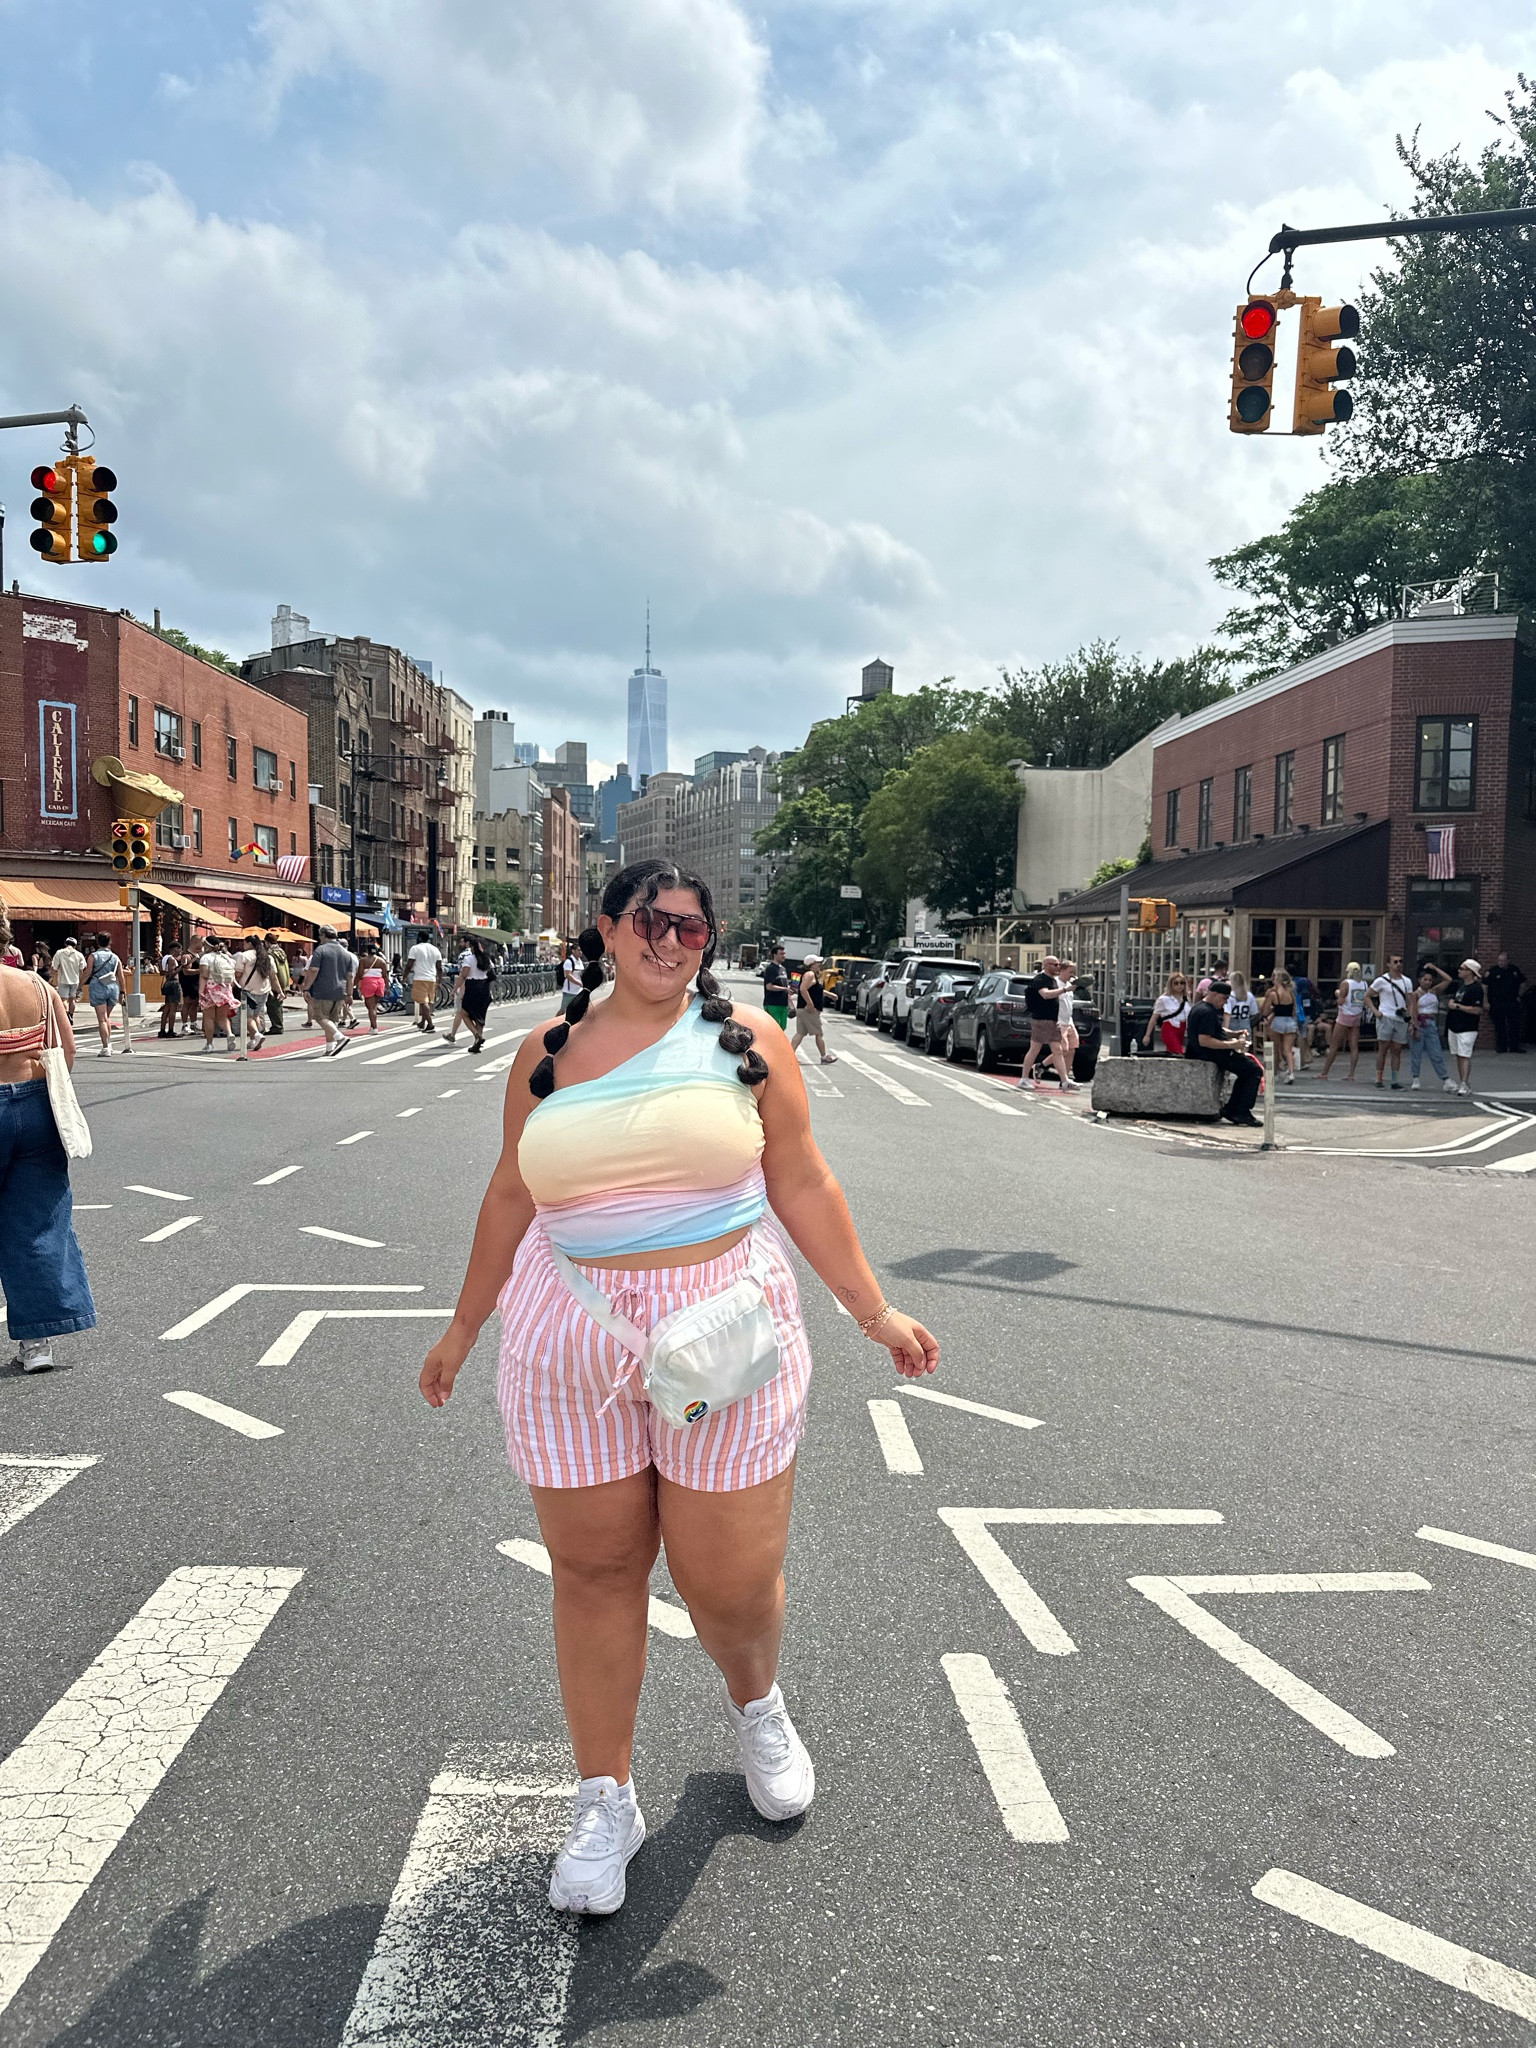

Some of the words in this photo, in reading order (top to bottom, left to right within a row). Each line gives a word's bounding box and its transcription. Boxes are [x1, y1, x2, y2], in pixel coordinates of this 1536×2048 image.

[51, 710, 63, 802] CALIENTE
[1364, 966, 1372, 975] A
[1231, 1005, 1250, 1019] 48
